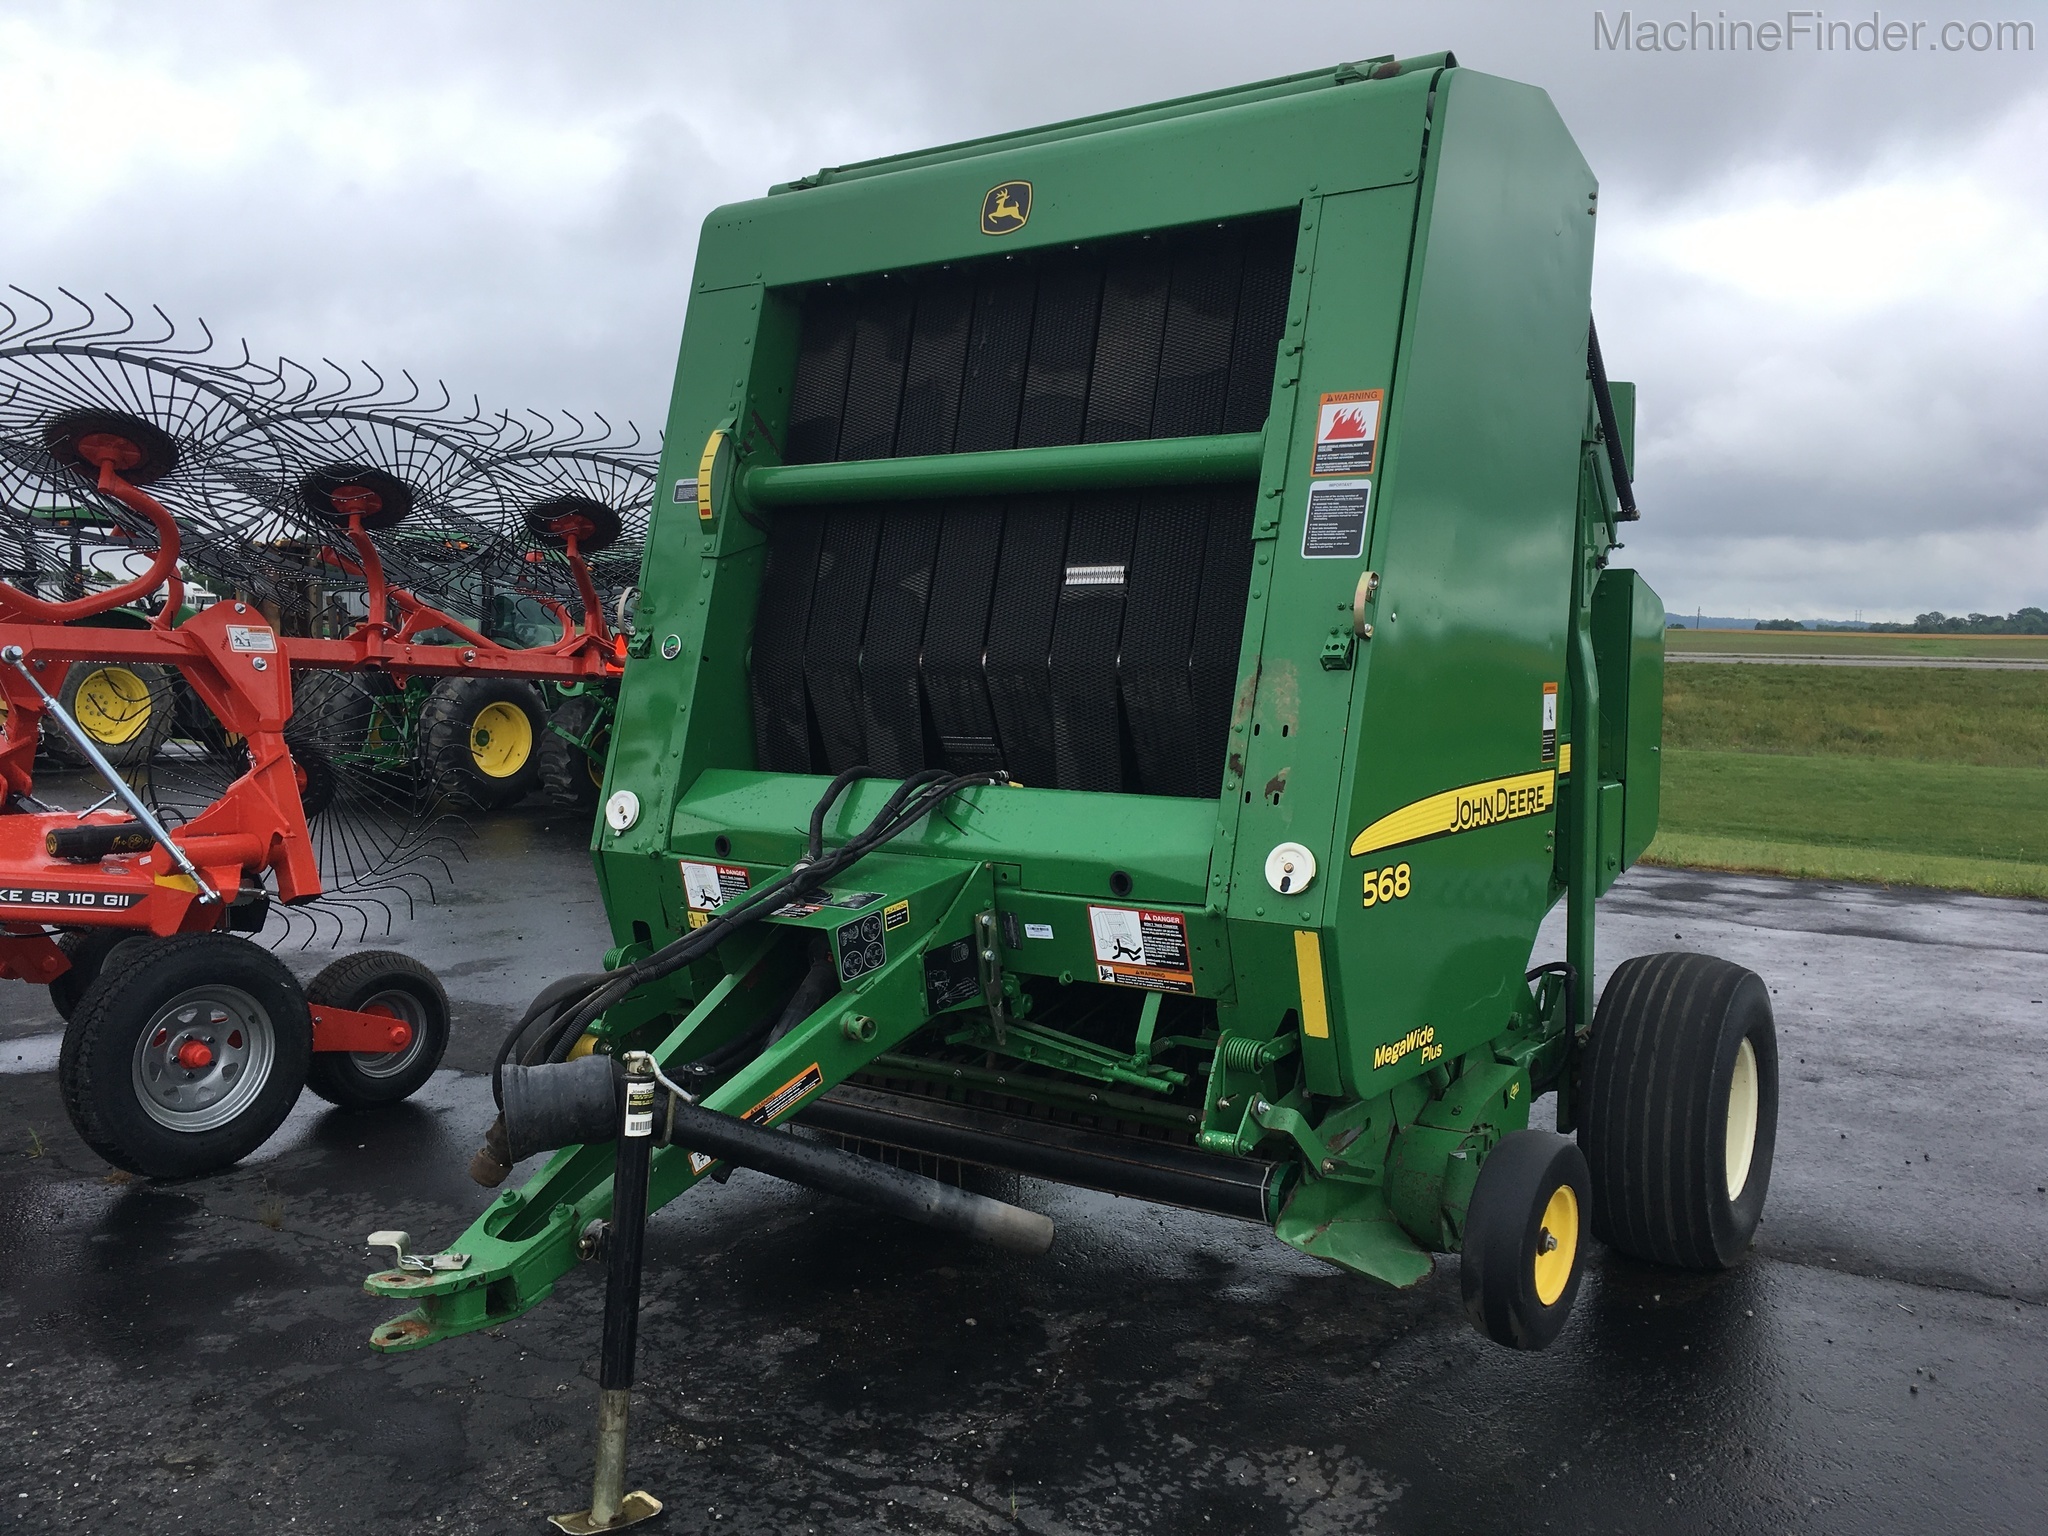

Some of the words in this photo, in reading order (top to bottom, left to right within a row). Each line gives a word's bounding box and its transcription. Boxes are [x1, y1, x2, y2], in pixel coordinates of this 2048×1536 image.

[1334, 391, 1378, 401] WARNING
[1450, 796, 1494, 830] JOHN
[1497, 785, 1546, 817] DEERE
[725, 869, 746, 877] DANGER
[1363, 863, 1411, 908] 568
[31, 890, 59, 904] SR
[68, 892, 95, 905] 110
[103, 894, 129, 907] GII
[1152, 915, 1180, 924] DANGER
[1373, 1024, 1434, 1070] MegaWide
[1421, 1043, 1443, 1065] Plus
